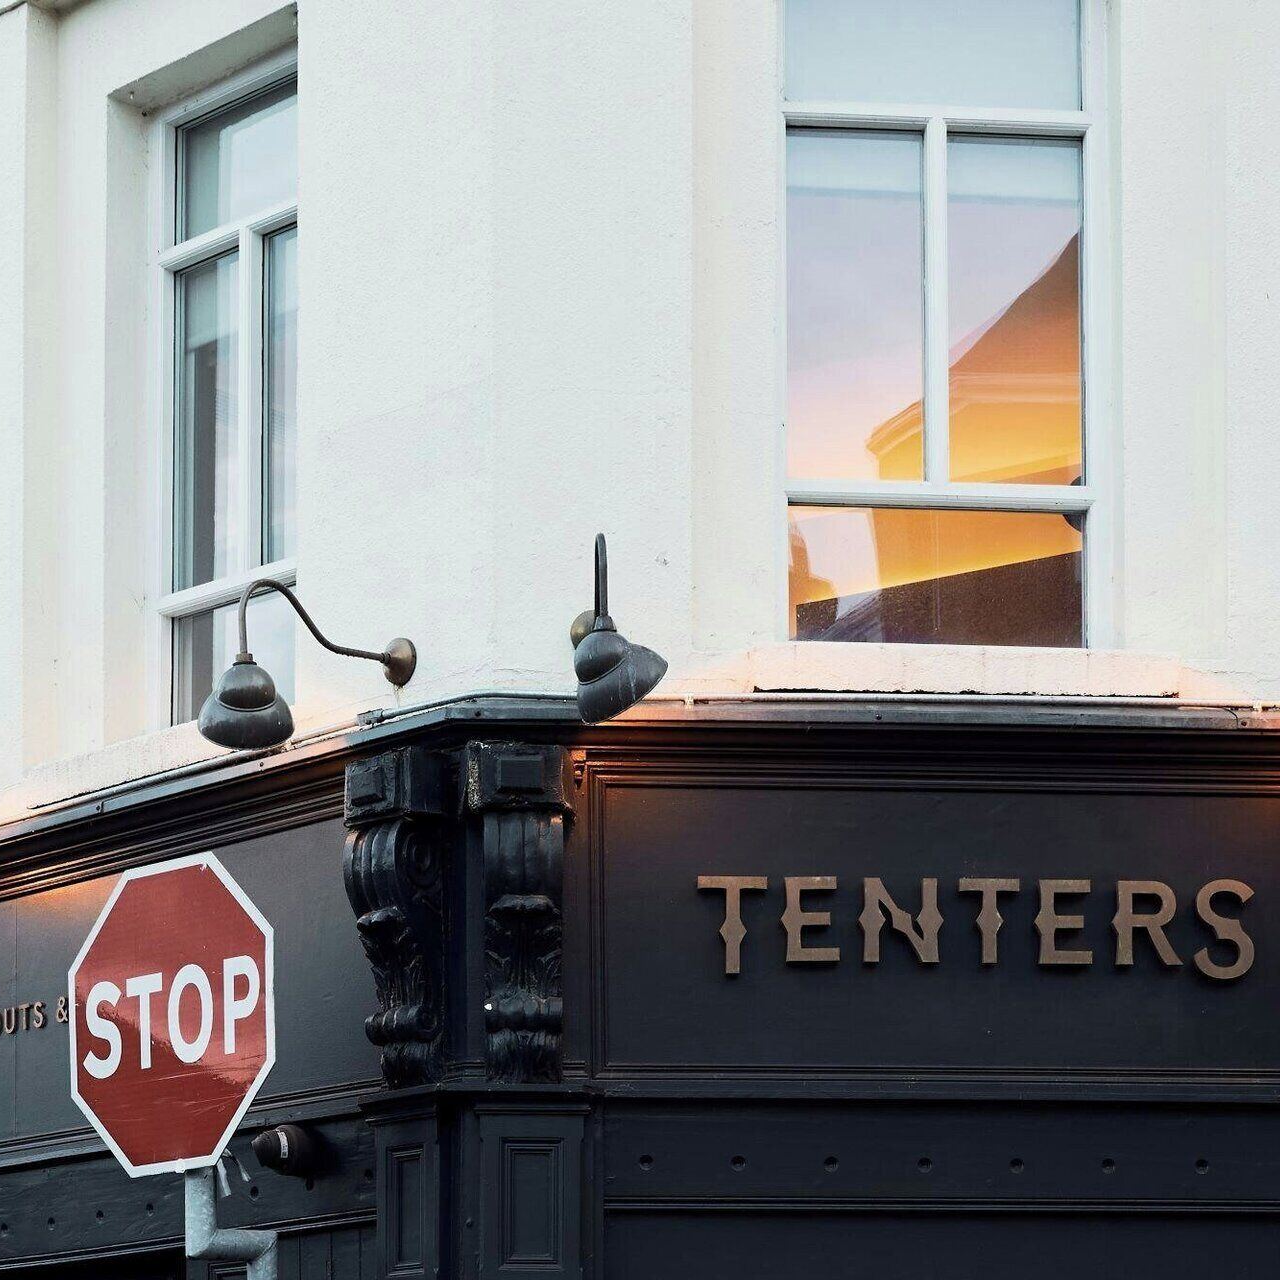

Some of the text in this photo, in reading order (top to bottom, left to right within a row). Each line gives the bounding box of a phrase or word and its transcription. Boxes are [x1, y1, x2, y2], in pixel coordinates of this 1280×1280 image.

[697, 875, 1255, 980] TENTERS
[56, 996, 68, 1023] &
[83, 955, 260, 1080] STOP
